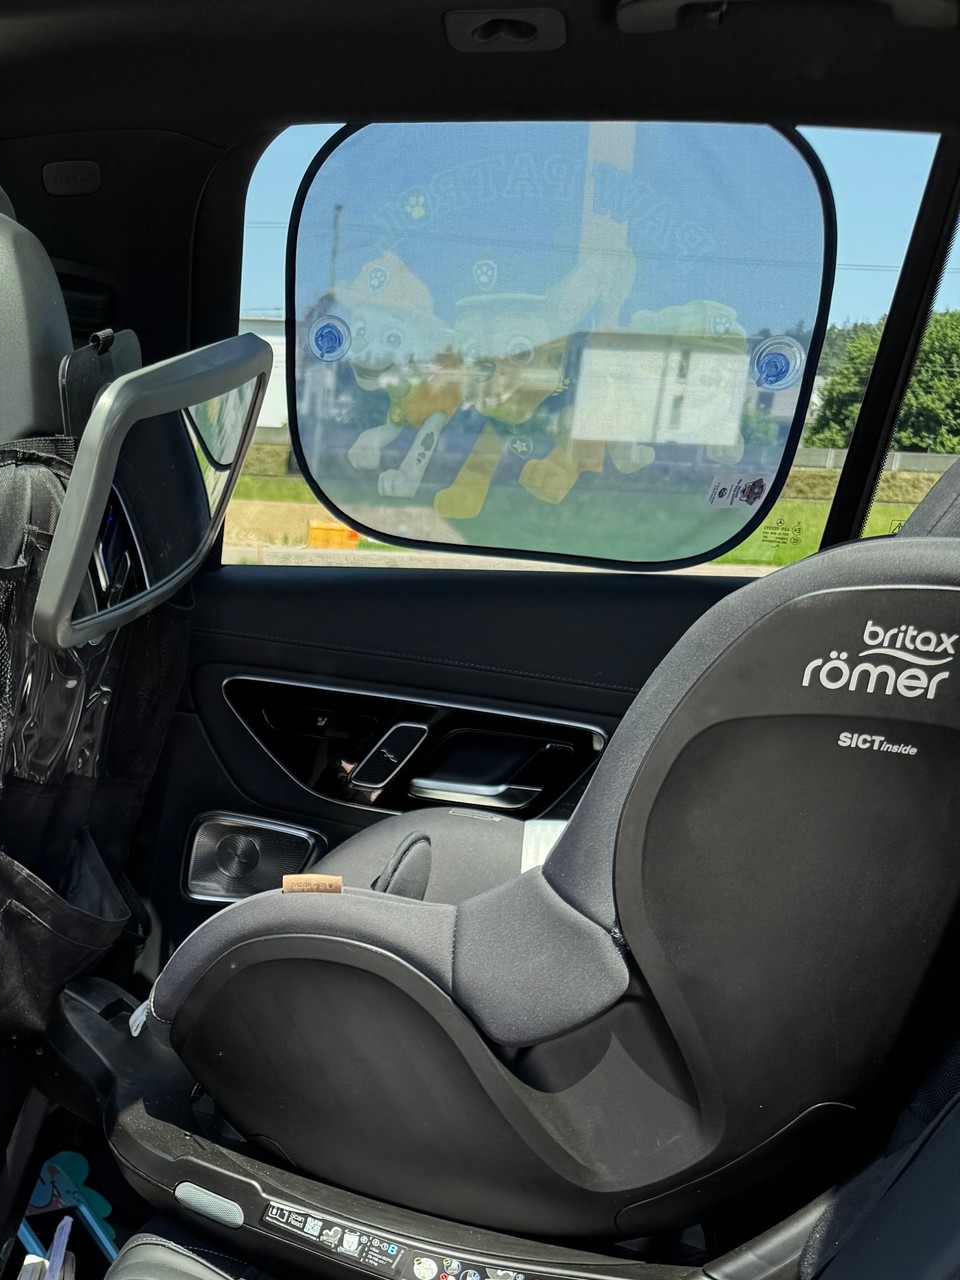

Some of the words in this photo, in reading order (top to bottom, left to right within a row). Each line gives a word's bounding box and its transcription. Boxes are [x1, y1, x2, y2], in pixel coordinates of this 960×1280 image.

[863, 620, 959, 654] britax
[802, 650, 950, 699] römer
[387, 1243, 398, 1255] B
